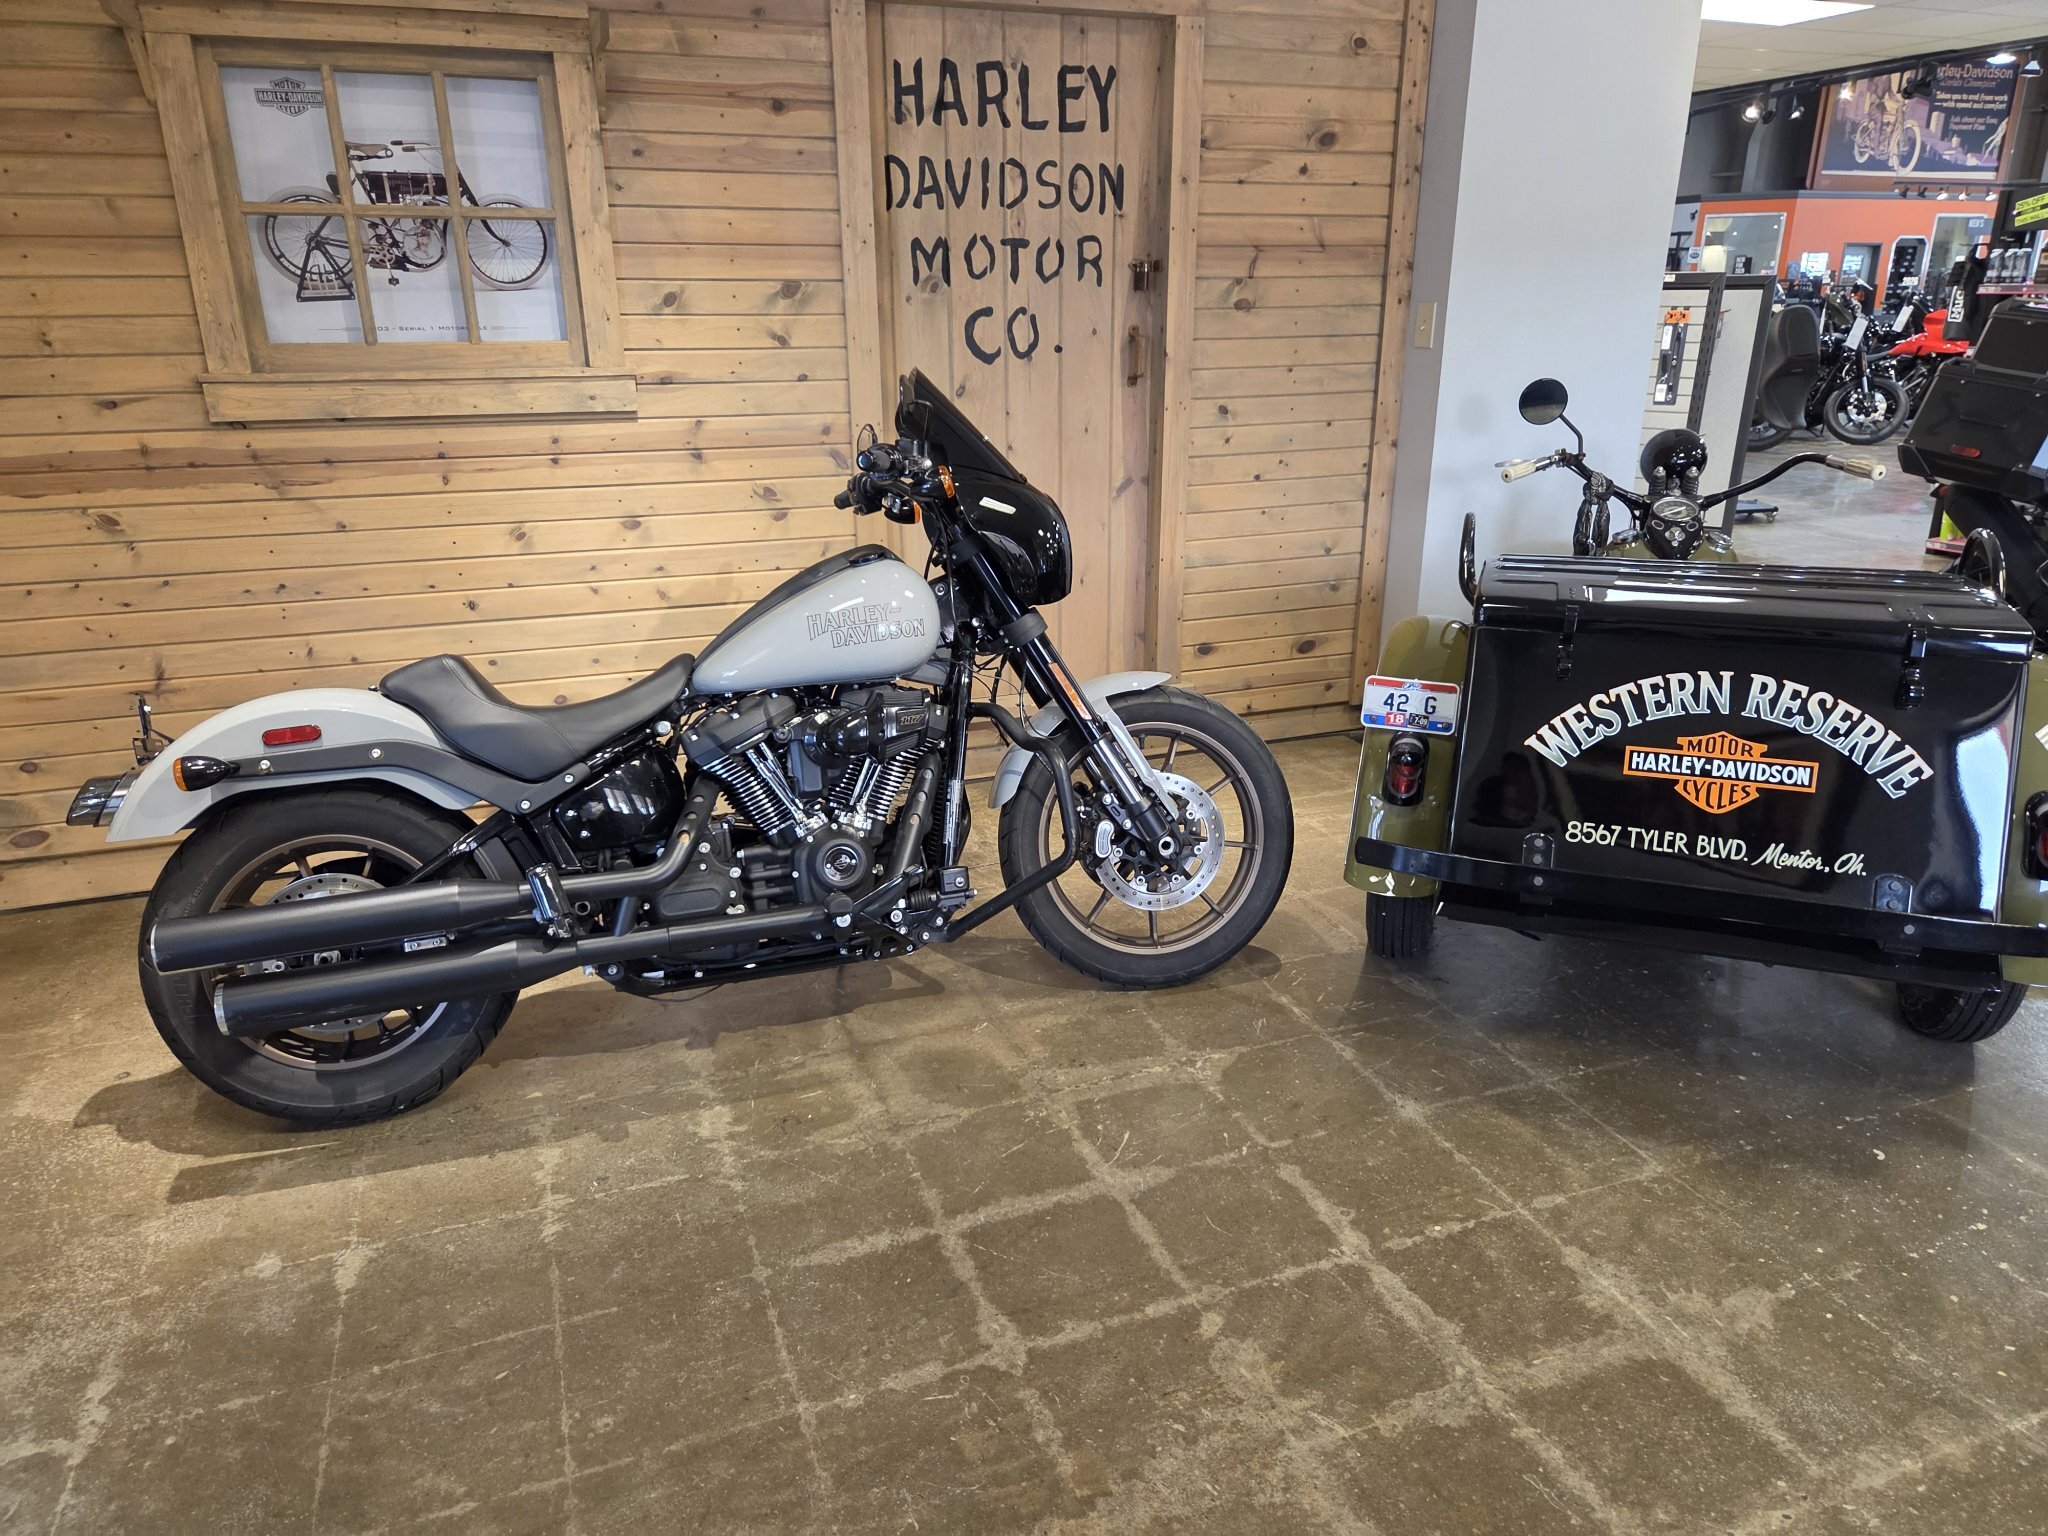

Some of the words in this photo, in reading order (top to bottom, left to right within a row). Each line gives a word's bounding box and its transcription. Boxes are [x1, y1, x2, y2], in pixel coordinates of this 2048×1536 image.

[256, 91, 323, 103] HARLEY-DAVIDSON
[273, 80, 302, 90] MOTOR
[893, 57, 1117, 133] HARLEY
[279, 105, 306, 114] CYCLES
[884, 154, 1125, 216] DAVIDSON
[910, 233, 1102, 287] MOTOR
[964, 306, 1063, 365] CO.
[807, 603, 902, 640] HARLEY-
[831, 619, 925, 648] DAVIDSON
[1383, 692, 1409, 713] 42
[1424, 696, 1437, 715] G
[1387, 714, 1405, 724] 18
[900, 713, 924, 726] 117
[1524, 671, 1735, 767] WESTERN
[1741, 674, 1934, 799] RESERVE
[1687, 734, 1753, 758] MOTOR
[1631, 752, 1811, 786] HARLEY-DAVIDSON
[1682, 779, 1752, 810] CYCLES
[1565, 820, 1622, 846] 8567
[1627, 826, 1689, 855] TYLER
[1697, 835, 1748, 862] BLVD.
[1751, 843, 1830, 873] Mentor,
[1833, 852, 1867, 876] Oh.
